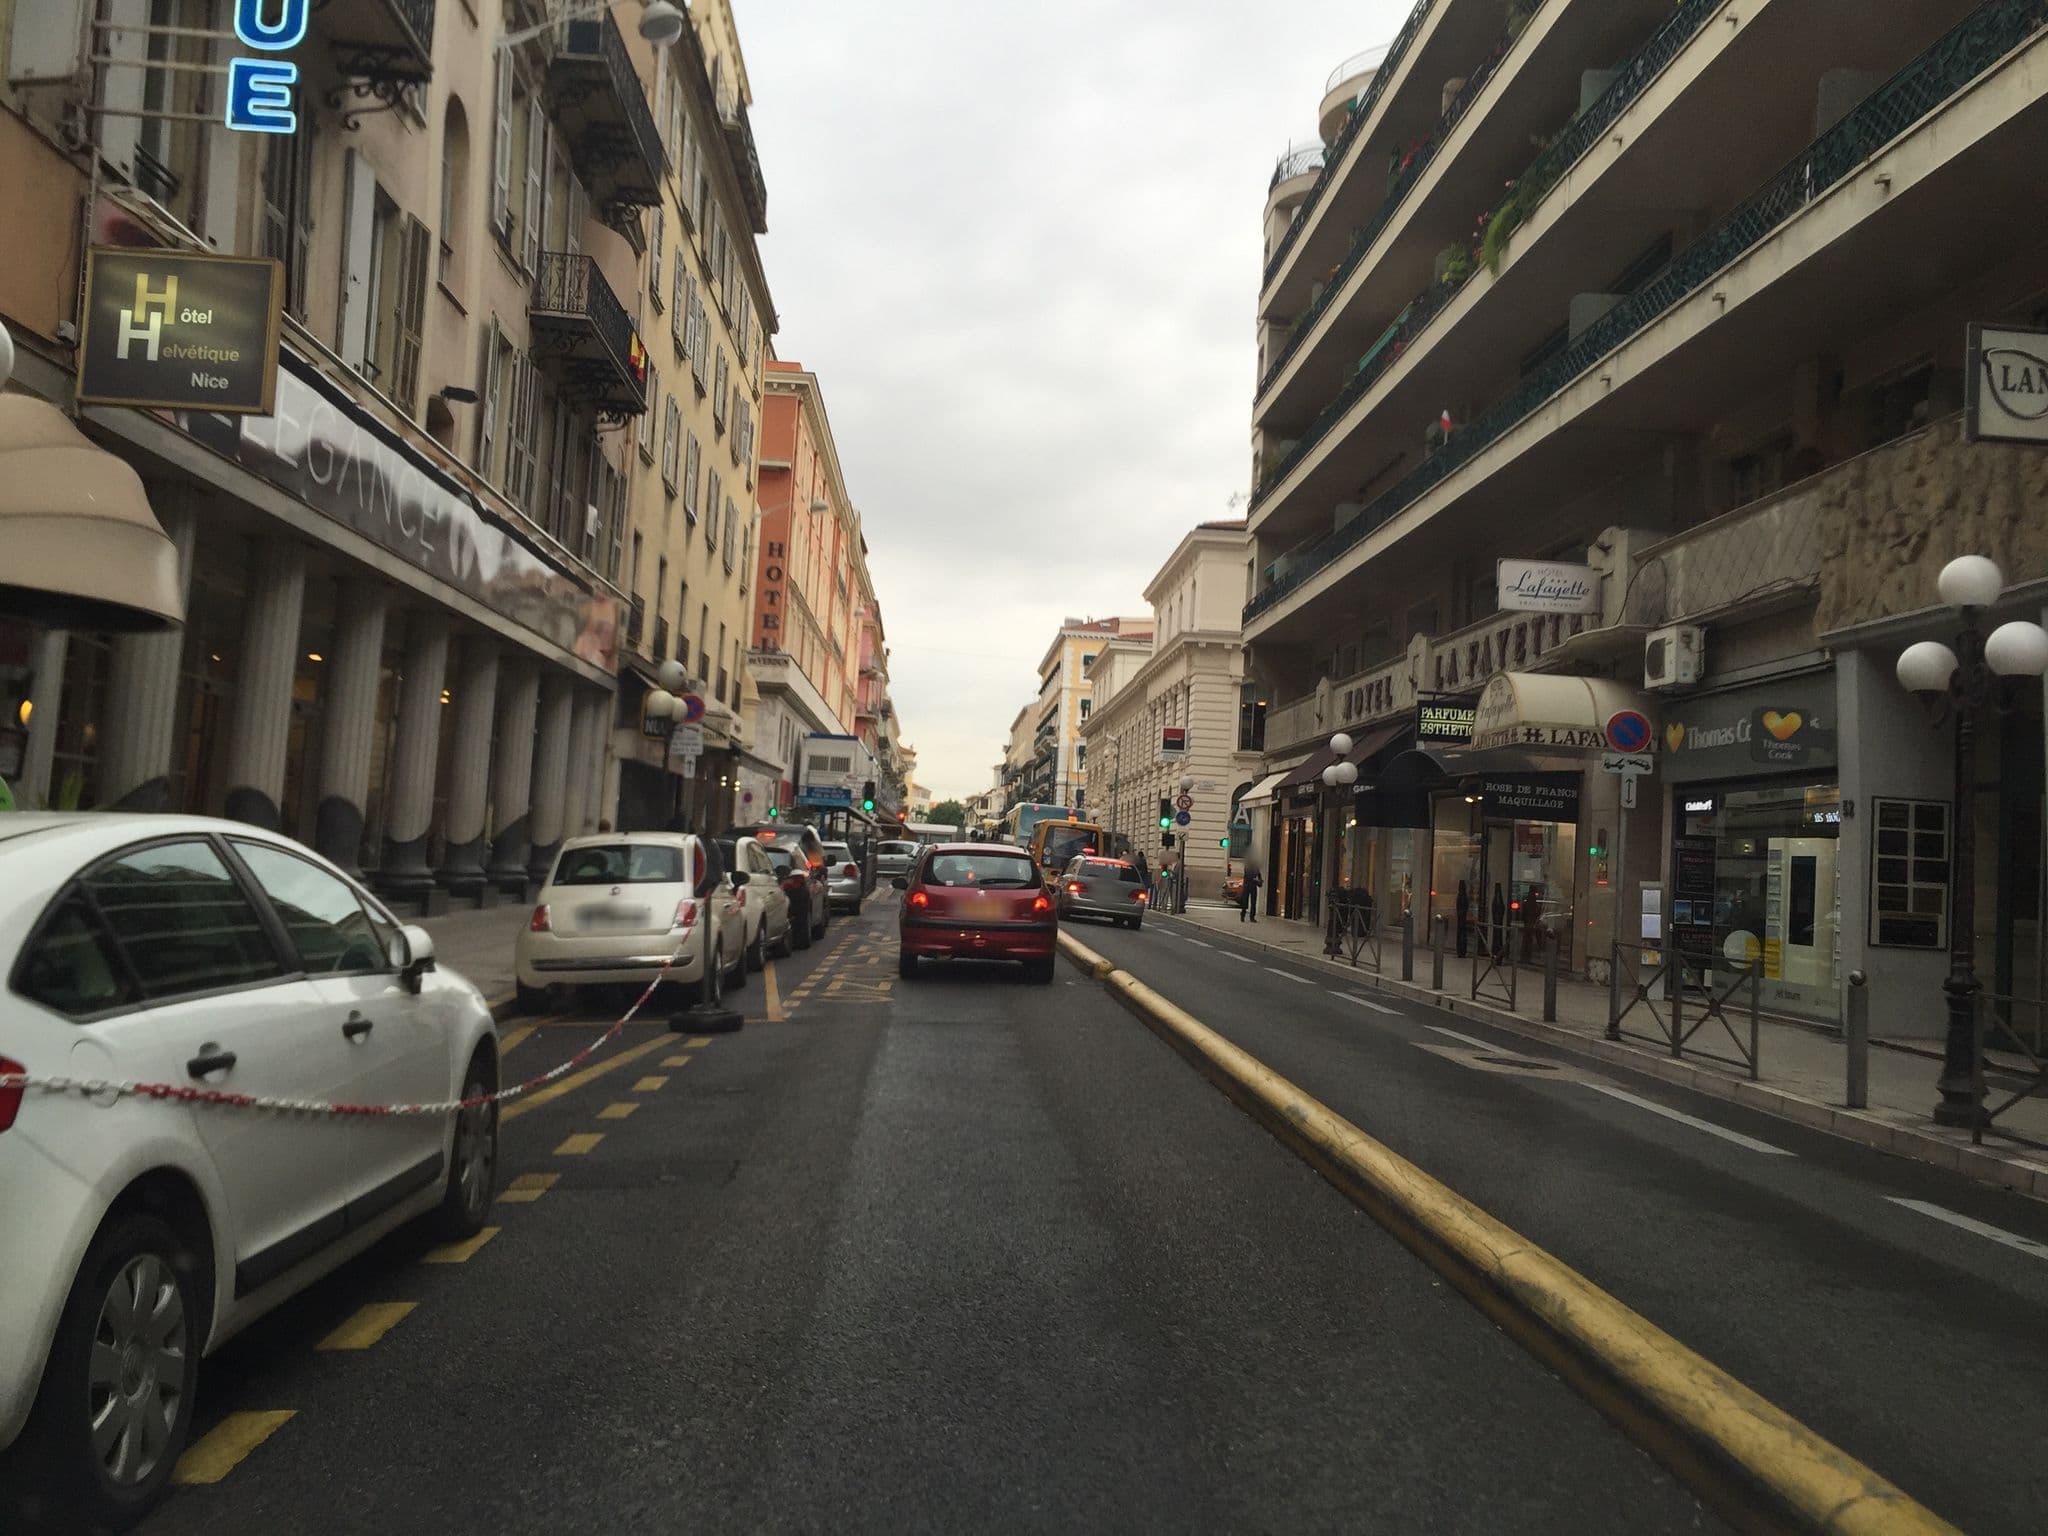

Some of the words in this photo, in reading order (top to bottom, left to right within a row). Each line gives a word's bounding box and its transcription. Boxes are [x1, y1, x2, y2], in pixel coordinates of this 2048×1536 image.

[116, 309, 241, 365] Helvétique
[191, 372, 229, 390] Nice
[1505, 570, 1591, 601] Lafayette
[1342, 675, 1394, 721] HOTEL
[1688, 727, 1736, 751] Thomas
[1763, 740, 1801, 751] Thomas
[1767, 750, 1793, 761] Cook
[1517, 784, 1536, 795] DE
[1499, 796, 1564, 810] MAQUILLAGE
